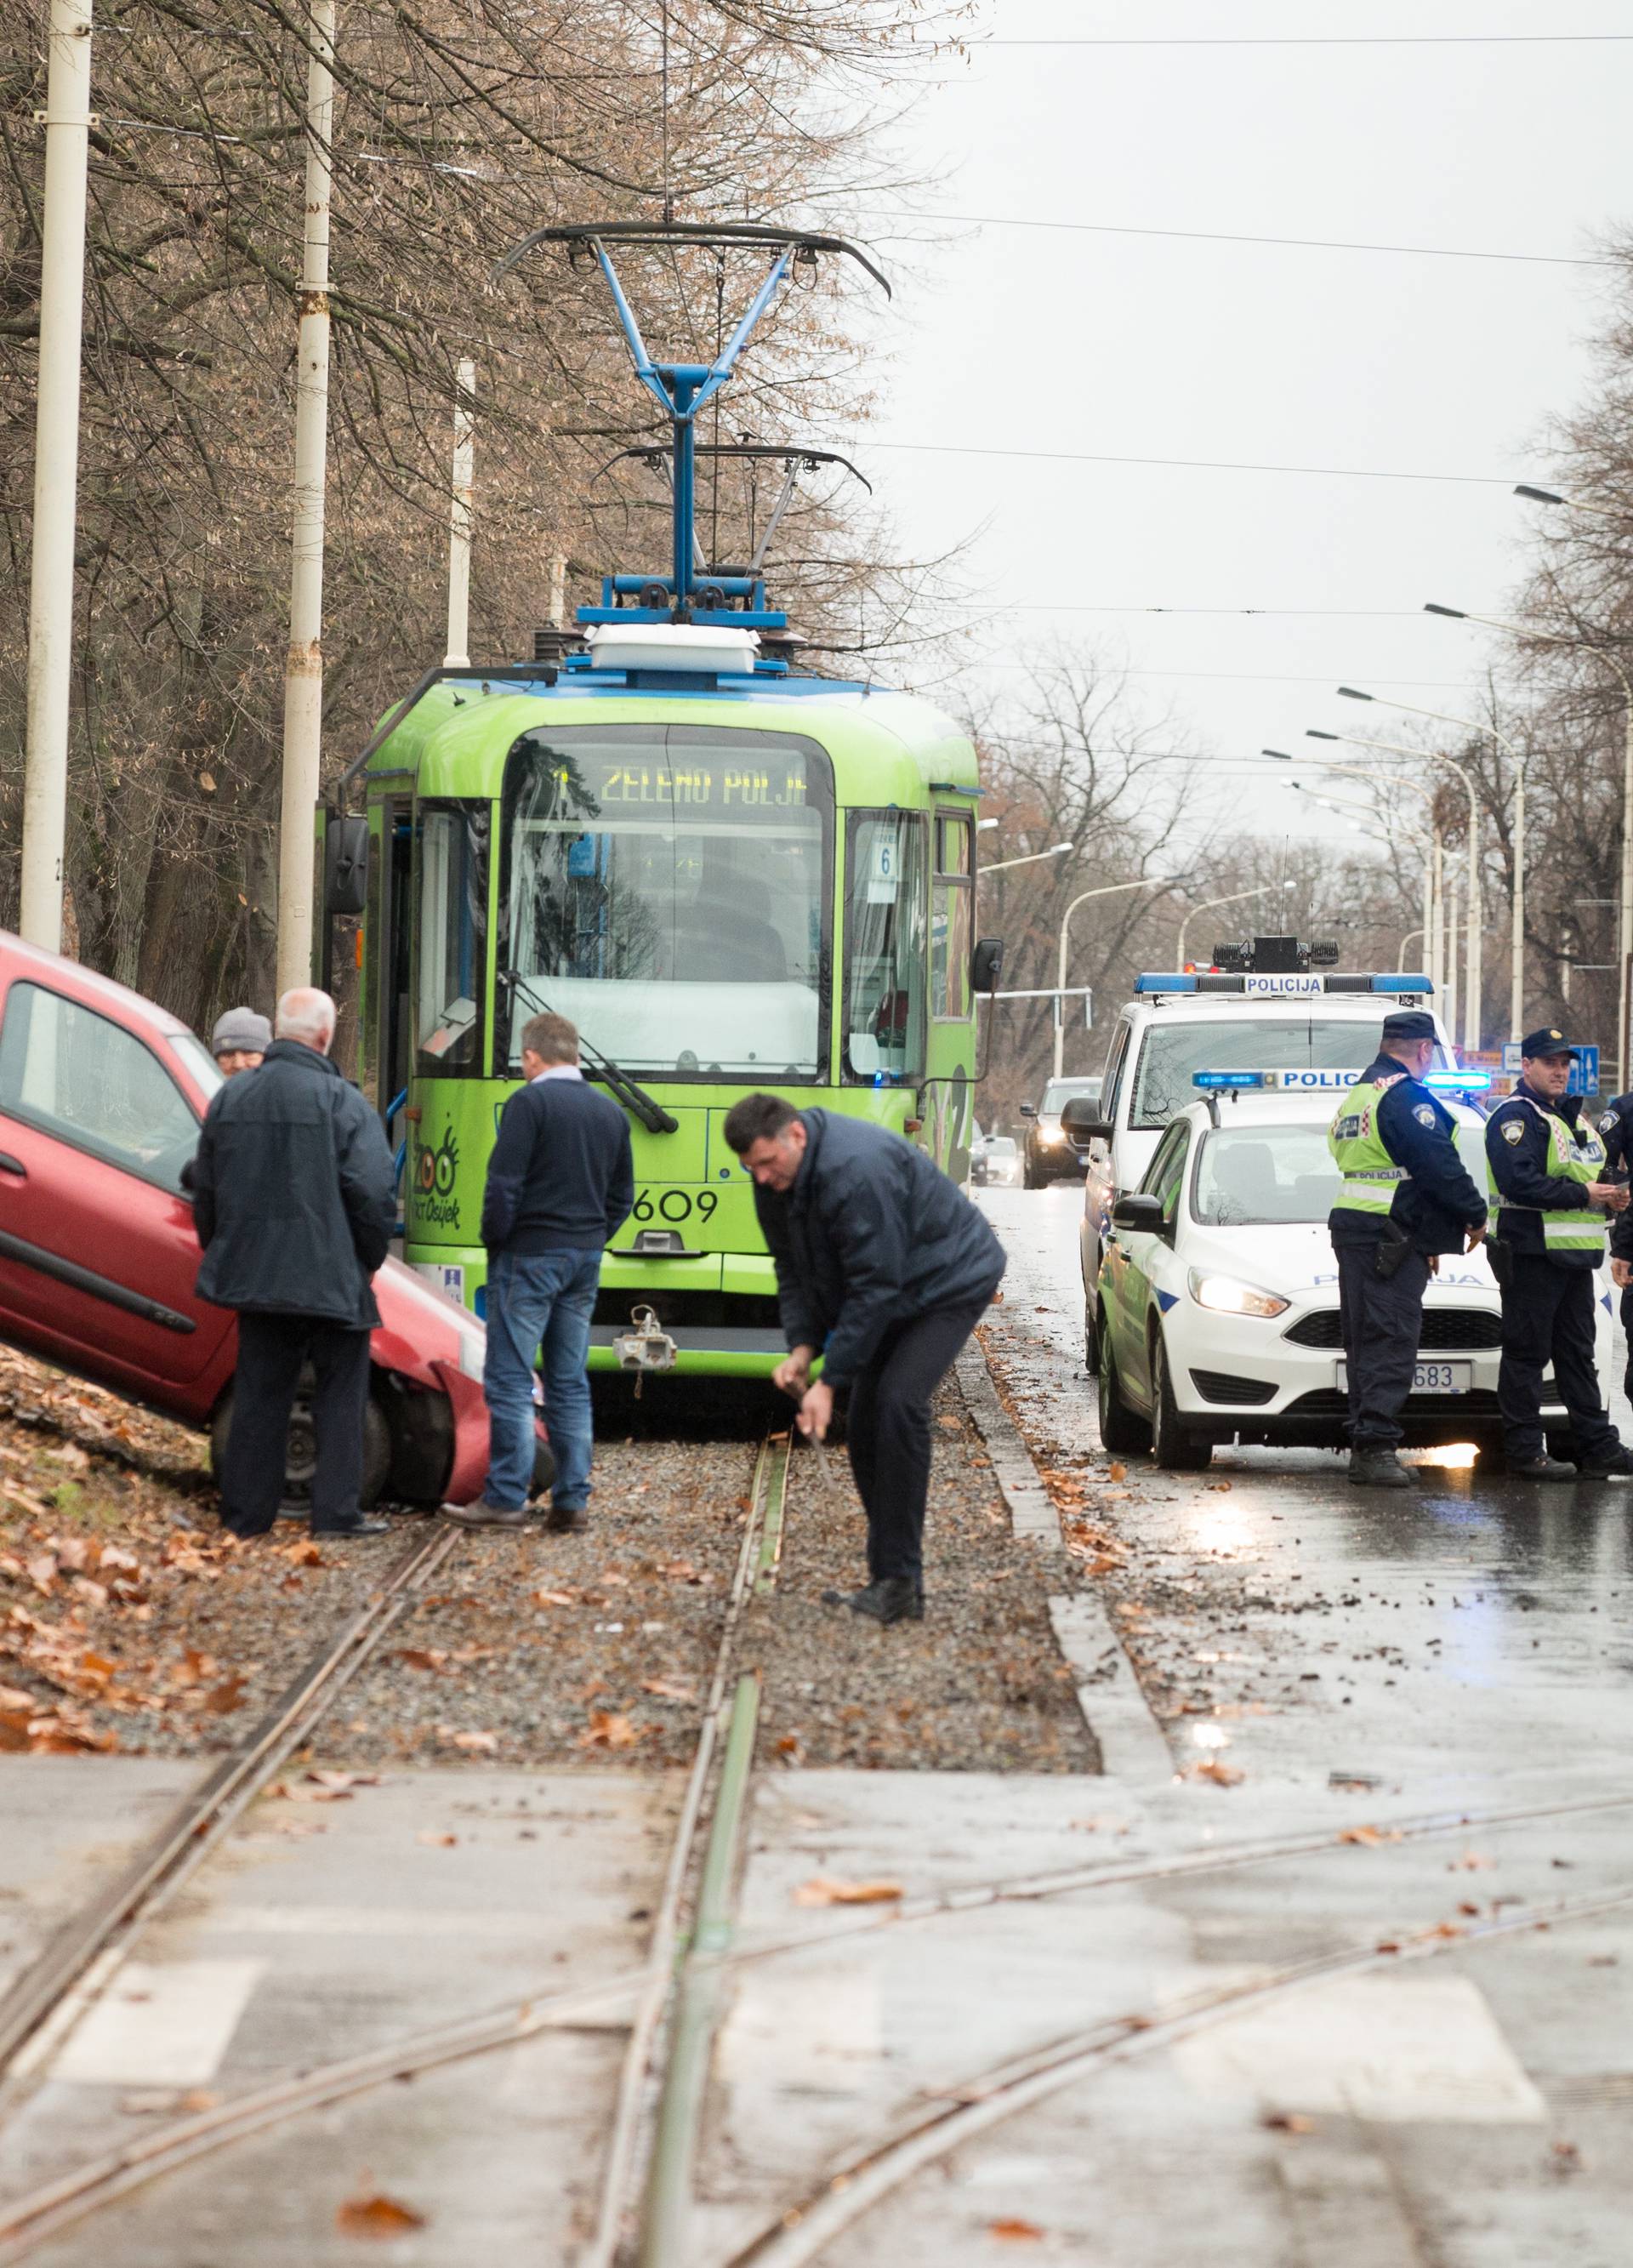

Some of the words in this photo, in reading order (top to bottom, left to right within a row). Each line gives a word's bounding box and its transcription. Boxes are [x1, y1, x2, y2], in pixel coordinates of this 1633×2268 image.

[881, 847, 890, 875] 6
[1247, 978, 1321, 992] POLICIJA
[1283, 1073, 1360, 1086] POLIC
[632, 1188, 718, 1223] 609
